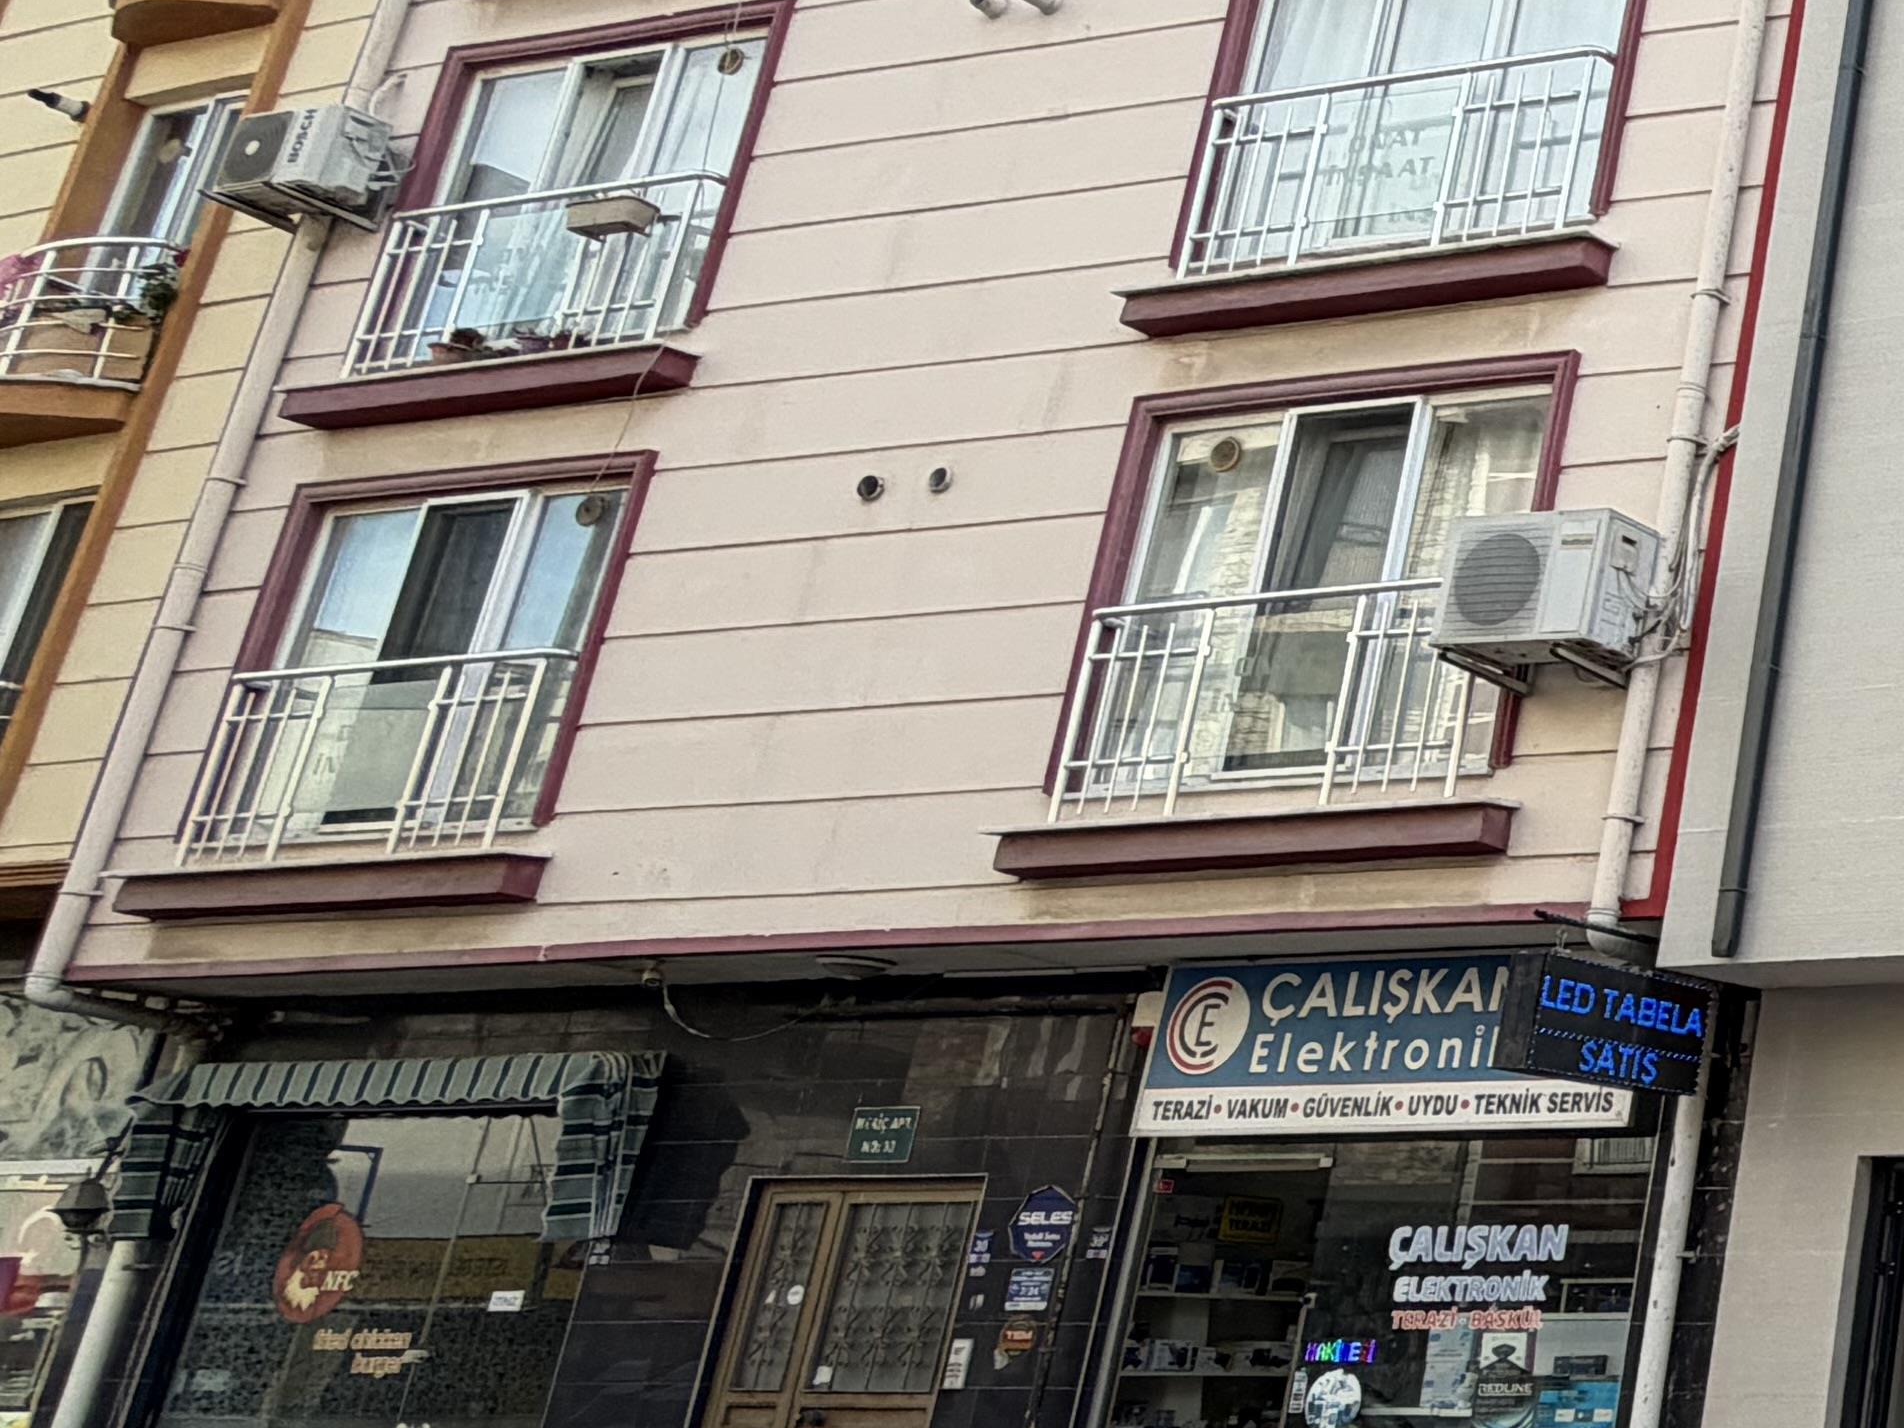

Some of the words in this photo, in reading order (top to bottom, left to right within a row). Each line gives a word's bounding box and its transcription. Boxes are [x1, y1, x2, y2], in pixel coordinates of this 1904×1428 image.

[1541, 975, 1596, 1014] LED
[1603, 988, 1705, 1037] TABELA
[1152, 1095, 1211, 1120] TERAZİ
[1227, 1098, 1289, 1119] VAKUM
[1303, 1091, 1394, 1118] GÜVENLİK
[1408, 1094, 1458, 1116] UYDU
[1474, 1088, 1541, 1115] TEKNİK
[1388, 1224, 1569, 1270] ÇALIŞKAN
[320, 1270, 360, 1291] NFC
[1393, 1270, 1549, 1302] ELEKTRONİK
[1392, 1307, 1457, 1329] TERAZİ
